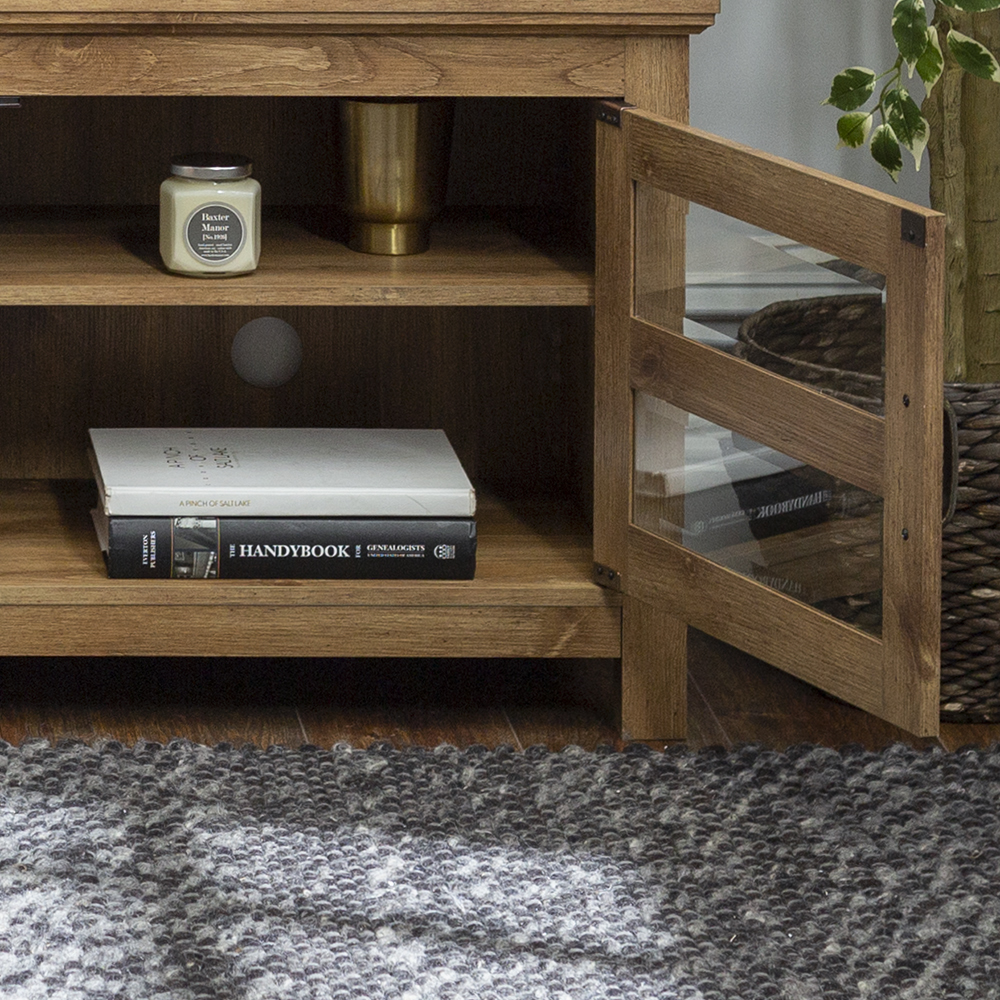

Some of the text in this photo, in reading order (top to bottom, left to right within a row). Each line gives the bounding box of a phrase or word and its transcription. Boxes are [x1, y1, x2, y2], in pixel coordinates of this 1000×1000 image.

[202, 212, 230, 221] Baxter
[201, 223, 230, 231] Manor
[239, 544, 351, 558] HANDYBOOK
